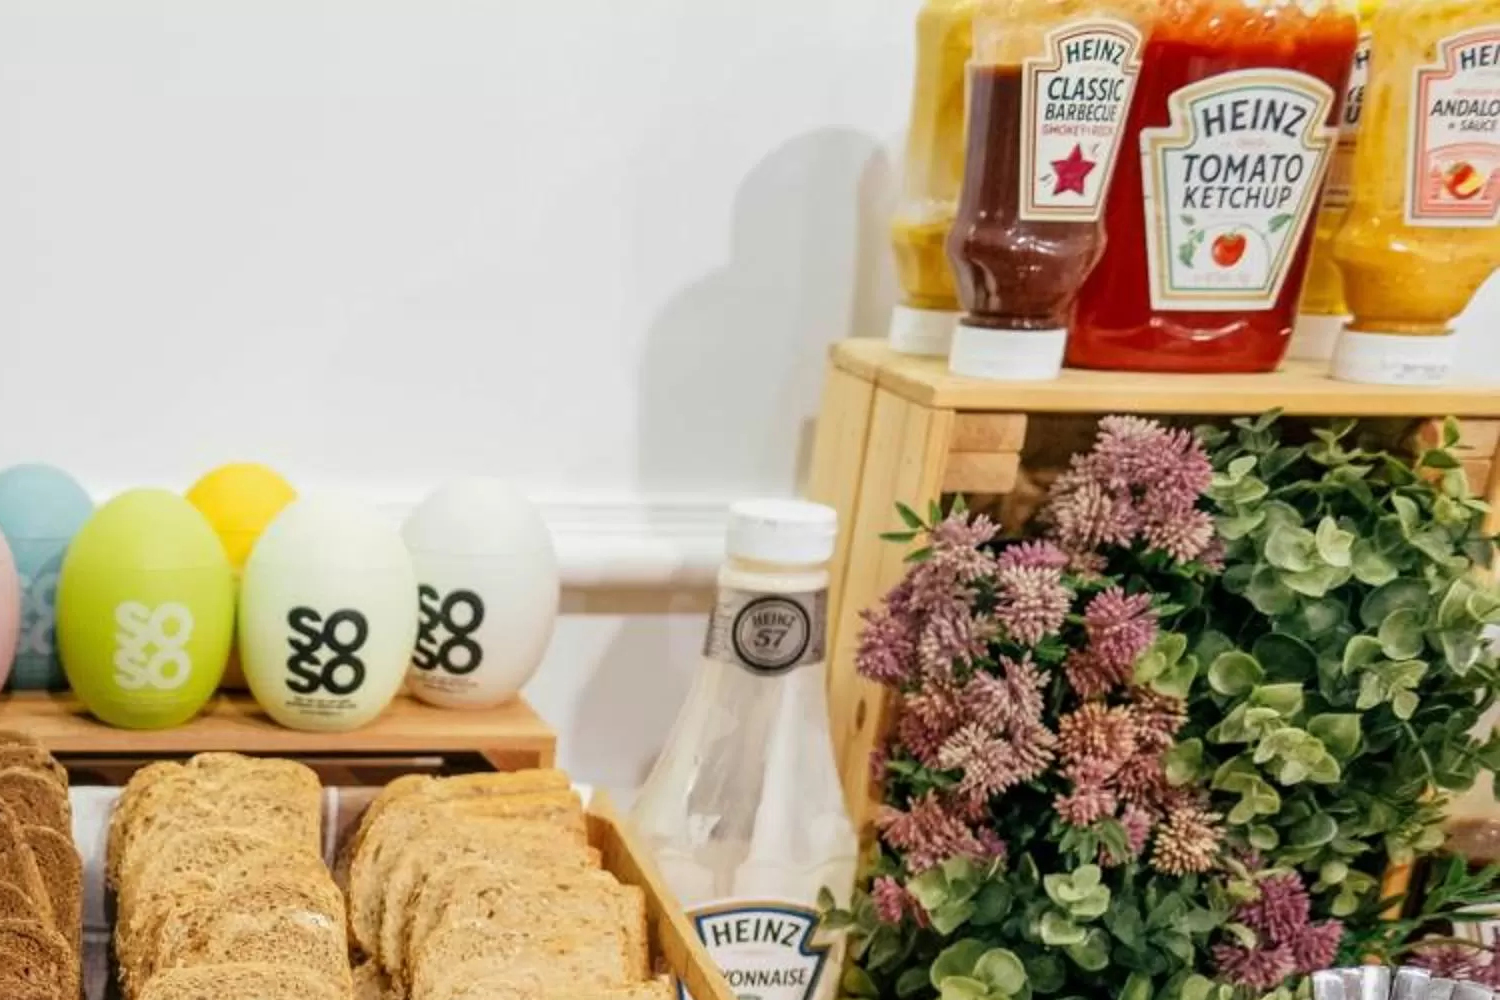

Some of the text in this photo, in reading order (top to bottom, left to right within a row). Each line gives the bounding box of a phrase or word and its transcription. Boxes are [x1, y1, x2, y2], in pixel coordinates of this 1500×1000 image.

[1066, 38, 1125, 65] HEINZ
[1461, 44, 1500, 70] HEI
[1047, 76, 1124, 102] CLASSIC
[1044, 103, 1118, 122] BARBECUE
[1202, 99, 1307, 138] HEINZ
[1430, 99, 1500, 117] ANDALO
[1460, 119, 1497, 132] SAUCE
[1182, 154, 1304, 185] TOMATO
[1182, 186, 1292, 209] KETCHUP
[752, 611, 797, 628] HEINZ
[754, 627, 789, 649] 57
[711, 918, 800, 947] HEINZ
[723, 967, 808, 987] YONNAISE
